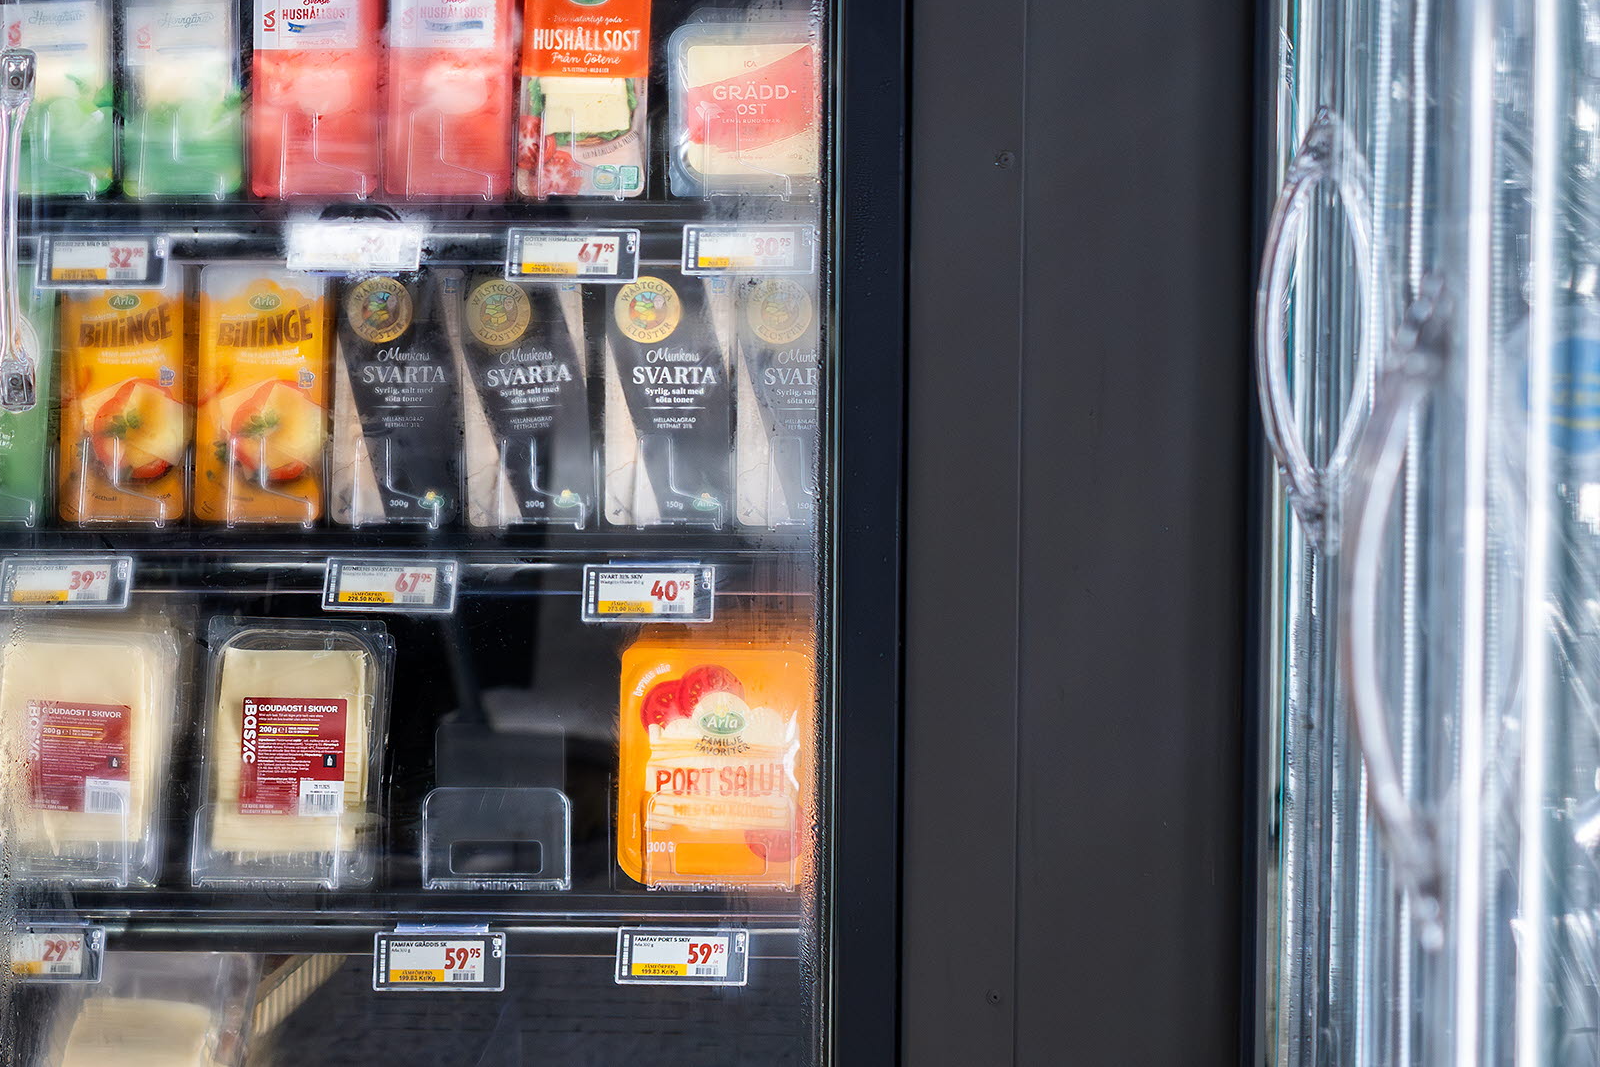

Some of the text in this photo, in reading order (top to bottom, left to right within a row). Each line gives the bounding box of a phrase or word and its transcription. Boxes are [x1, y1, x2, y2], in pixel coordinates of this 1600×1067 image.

[263, 9, 276, 32] ICA
[281, 4, 351, 21] HUSHÅLLSOST
[533, 27, 640, 52] HUSHÅLLSOST
[551, 51, 622, 66] Från Götene
[712, 81, 797, 101] GRÄDD-
[736, 103, 767, 115] OST
[621, 280, 674, 303] WÄSTGÖTA
[113, 296, 135, 307] Arla
[253, 297, 275, 307] Arla
[646, 347, 701, 365] Munkens
[362, 366, 447, 384] SVARTA
[486, 364, 573, 387] SVARTA
[632, 366, 717, 385] SVARTA
[644, 387, 704, 397] Syrlig, salt med
[655, 395, 672, 403] söta
[308, 705, 338, 713] SKIVOR
[707, 713, 739, 730] Arla
[693, 741, 751, 756] FAVORITER
[700, 734, 745, 748] FAMILJE
[656, 763, 790, 795] PORT SALUT
